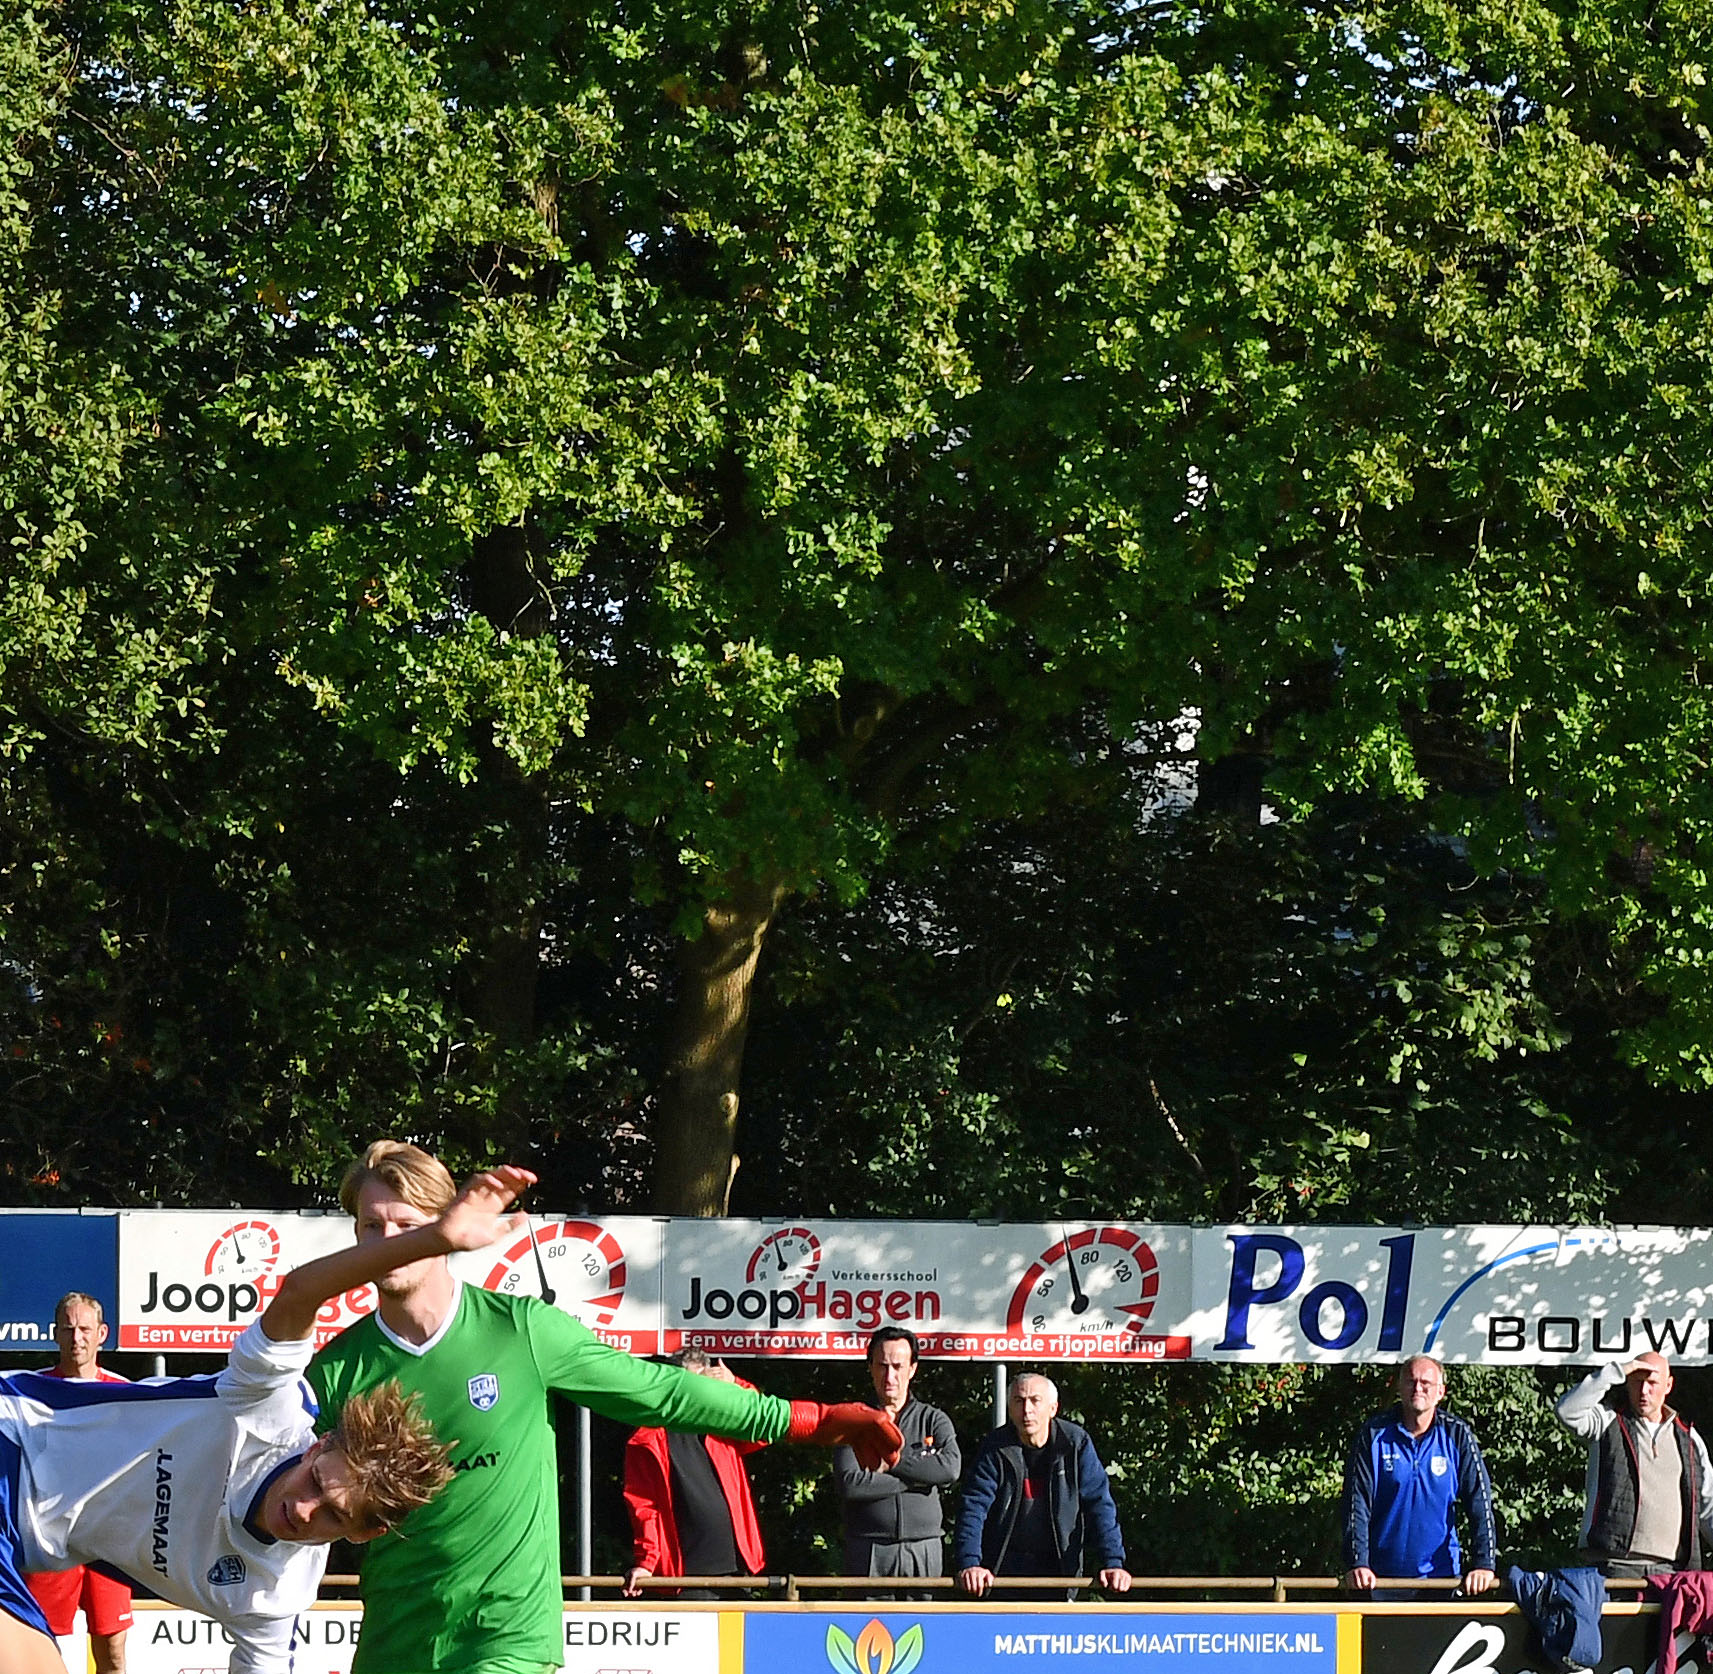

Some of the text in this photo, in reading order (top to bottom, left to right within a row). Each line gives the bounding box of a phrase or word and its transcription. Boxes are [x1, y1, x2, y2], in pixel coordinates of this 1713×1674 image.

[548, 1245, 567, 1258] 80
[1080, 1251, 1099, 1265] 80
[580, 1252, 602, 1277] 120
[832, 1269, 937, 1282] Verkeersschool
[1113, 1259, 1133, 1283] 120
[1037, 1278, 1054, 1298] 50
[1213, 1233, 1415, 1351] Pol
[139, 1327, 175, 1343] Een
[681, 1331, 716, 1348] Een
[721, 1331, 828, 1349] vertrouwd
[942, 1338, 979, 1351] een
[983, 1336, 1044, 1355] goede
[1049, 1334, 1166, 1358] rijopleiding
[152, 1449, 173, 1577] LAGEMAAT
[995, 1633, 1324, 1655] MATTHIJSKLIMAATTECHNIEK.NL
